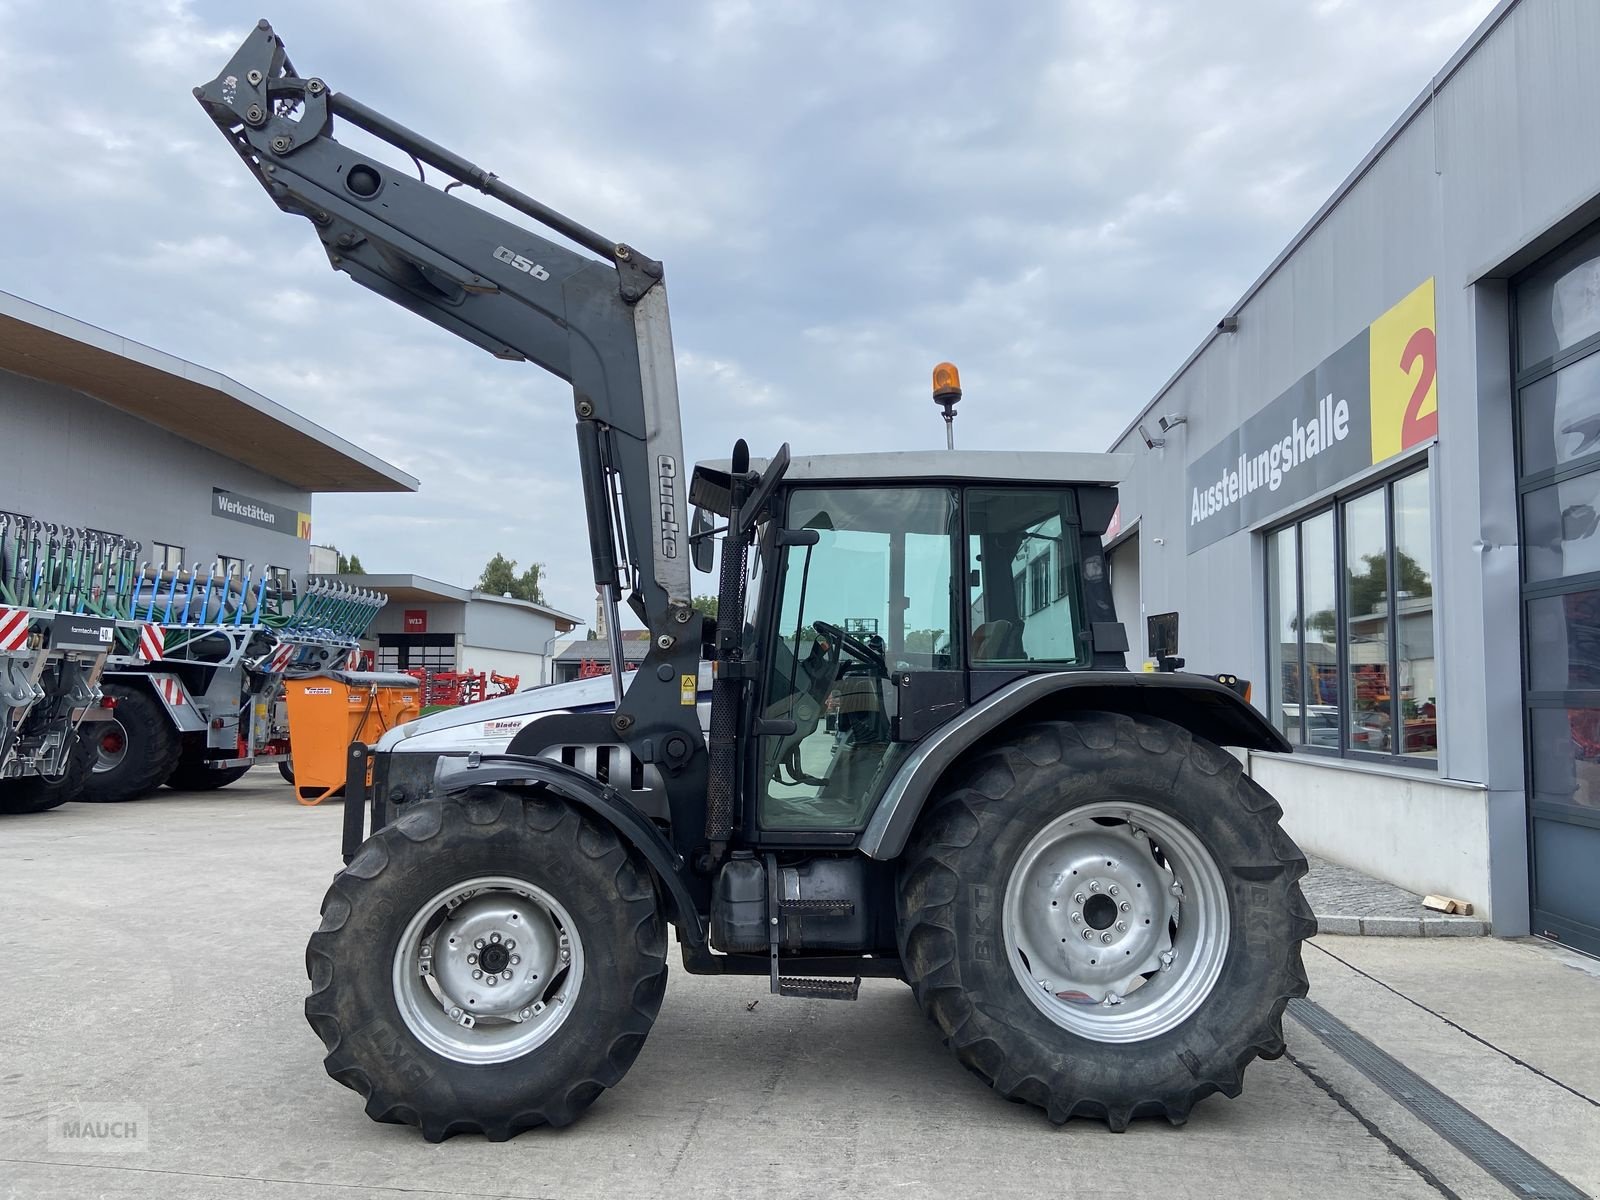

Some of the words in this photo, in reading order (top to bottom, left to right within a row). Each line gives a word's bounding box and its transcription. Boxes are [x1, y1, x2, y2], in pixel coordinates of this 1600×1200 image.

[1190, 393, 1349, 525] Ausstellungshalle
[1400, 327, 1438, 451] 2
[218, 495, 275, 523] Werkstätten
[408, 617, 423, 625] W13
[970, 886, 992, 962] BKT
